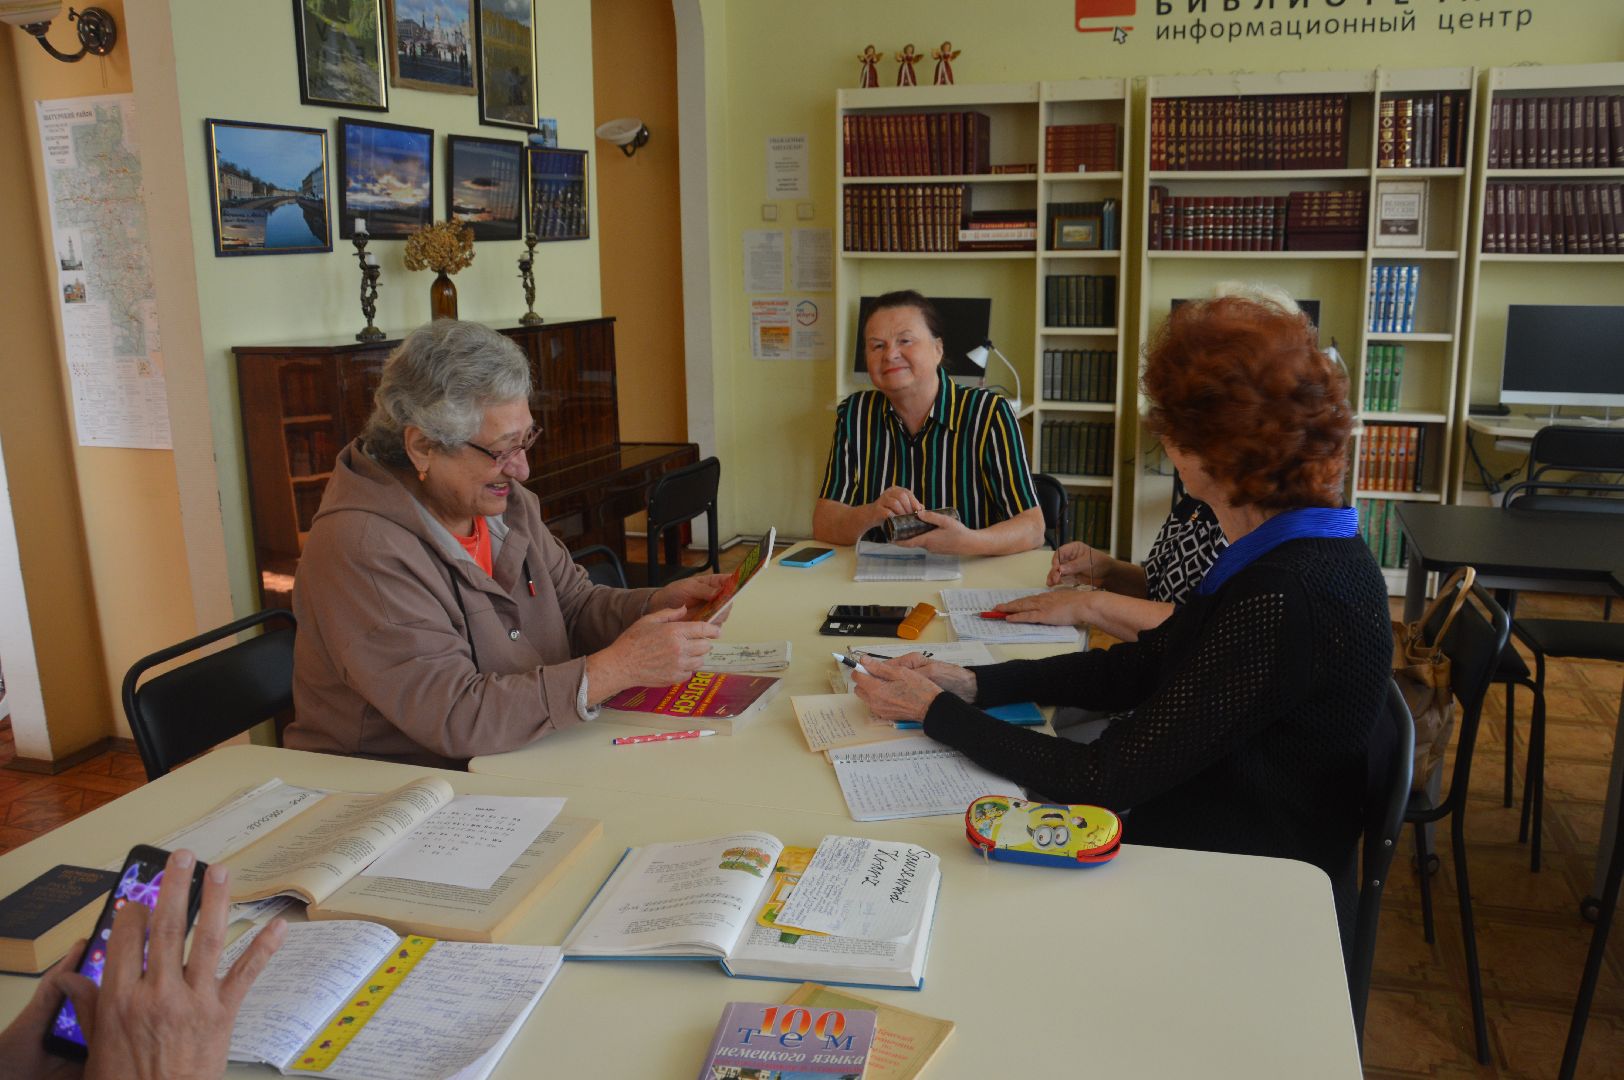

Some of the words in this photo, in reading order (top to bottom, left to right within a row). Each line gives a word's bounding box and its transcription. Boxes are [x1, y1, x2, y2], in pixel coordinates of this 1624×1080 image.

[1156, 9, 1416, 44] информационный
[1438, 8, 1533, 34] центр
[670, 672, 715, 713] DEUTSCH
[759, 1006, 847, 1042] 100
[716, 1045, 806, 1062] немецкого
[810, 1053, 865, 1065] языка
